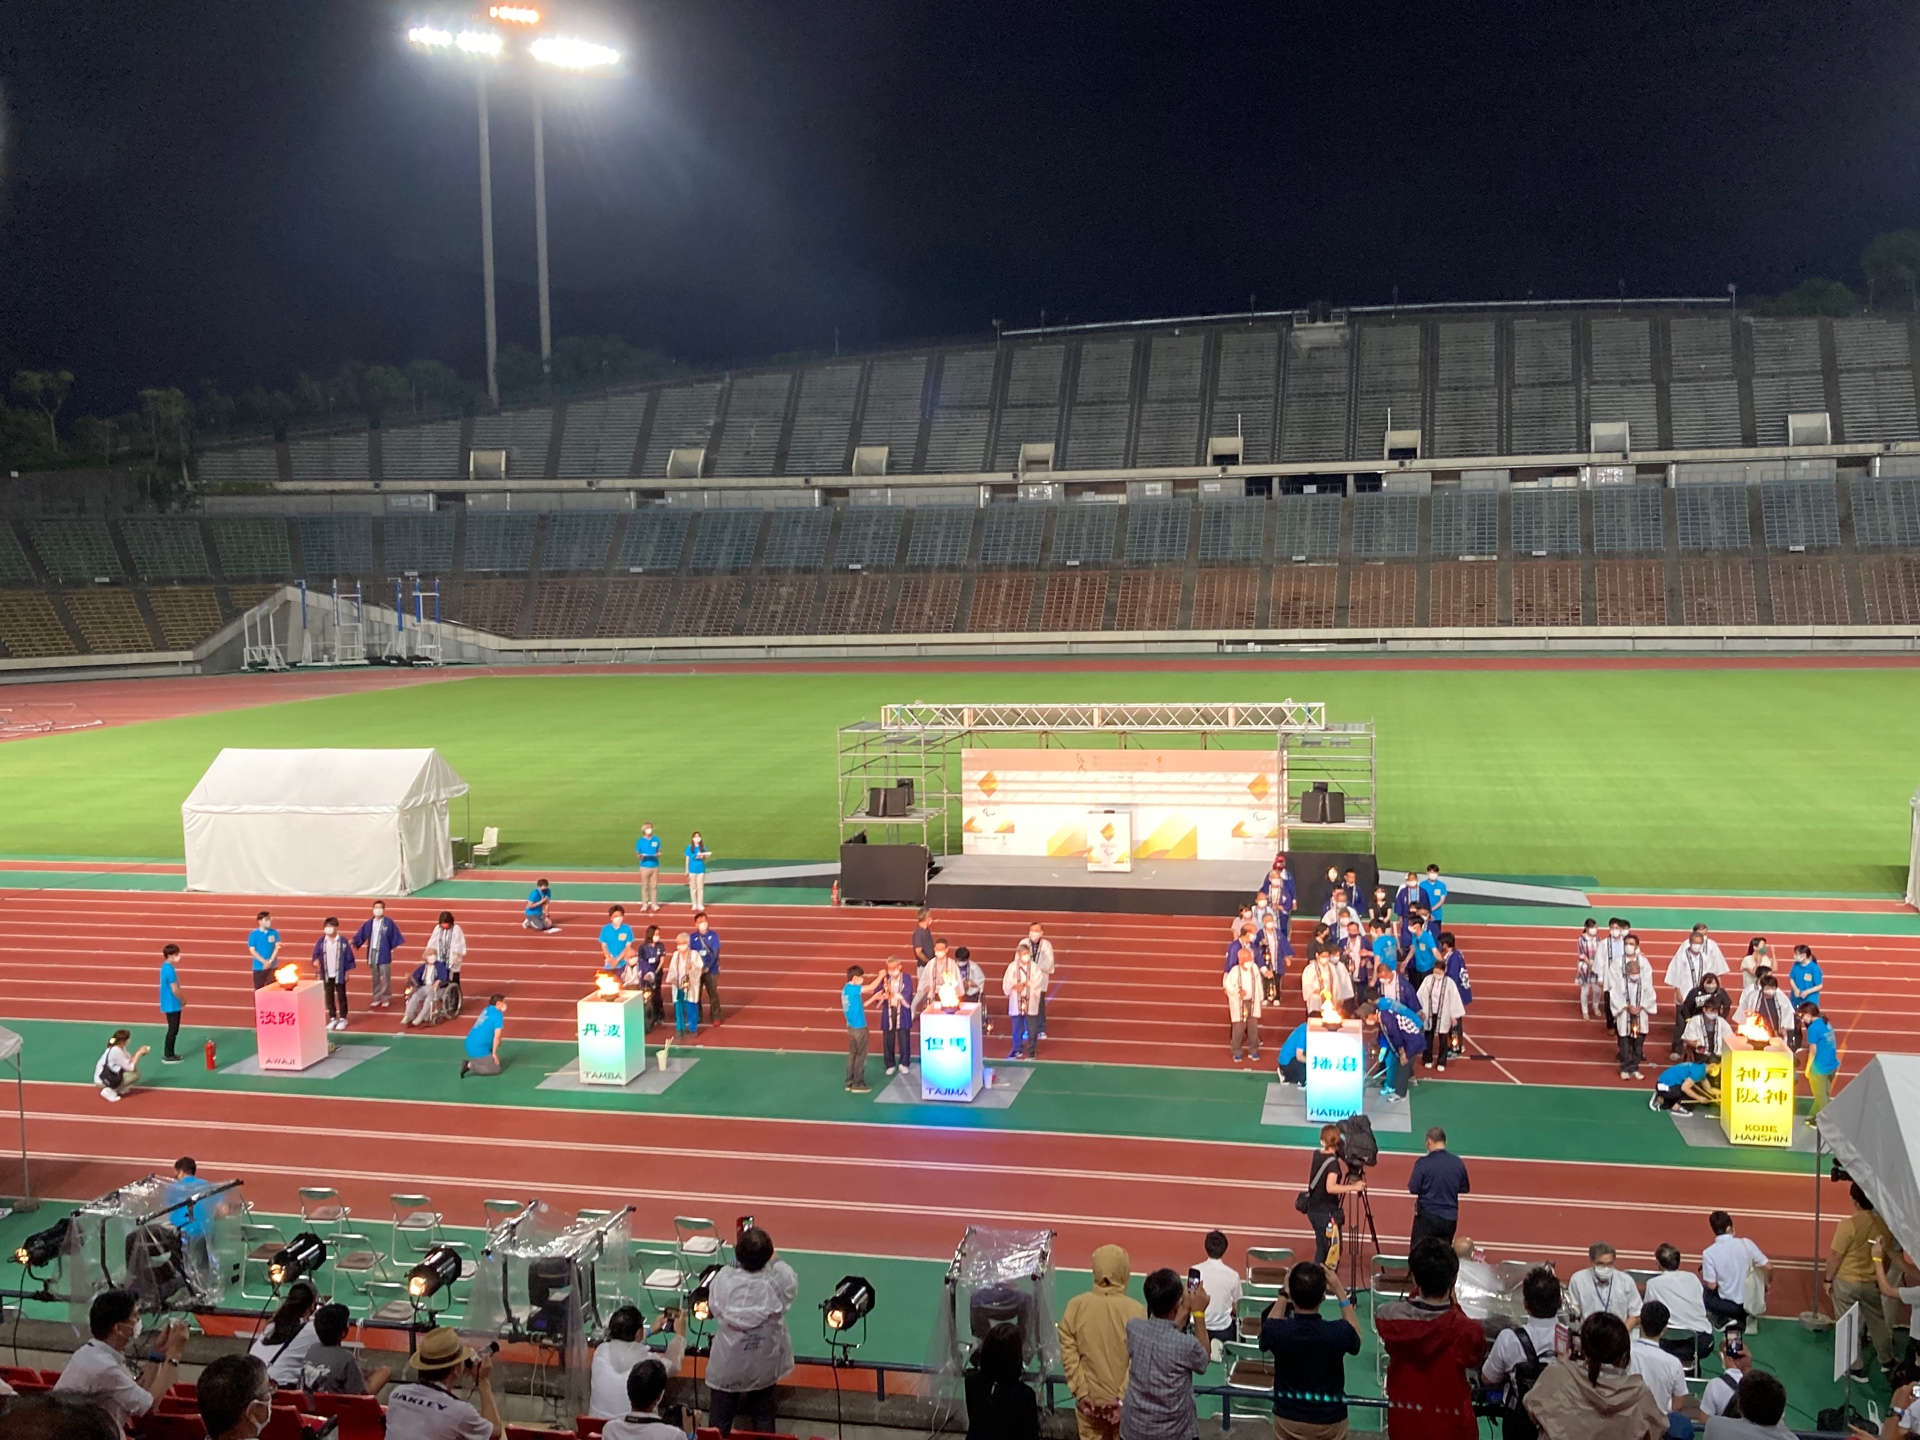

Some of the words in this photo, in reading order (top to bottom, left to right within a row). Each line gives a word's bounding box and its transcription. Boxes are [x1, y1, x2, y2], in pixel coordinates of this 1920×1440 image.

[260, 1011, 297, 1026] 淡路
[582, 1023, 621, 1037] 丹波
[924, 1036, 967, 1052] 但馬
[265, 1057, 296, 1065] AWAJI
[583, 1071, 623, 1080] TAMBA
[1736, 1066, 1788, 1083] 神戸
[926, 1087, 968, 1097] TAJIMA
[1736, 1087, 1788, 1105] 阪神
[1310, 1108, 1358, 1117] HARIMA
[1745, 1124, 1778, 1133] KOBE
[1734, 1133, 1789, 1143] HANSHIN
